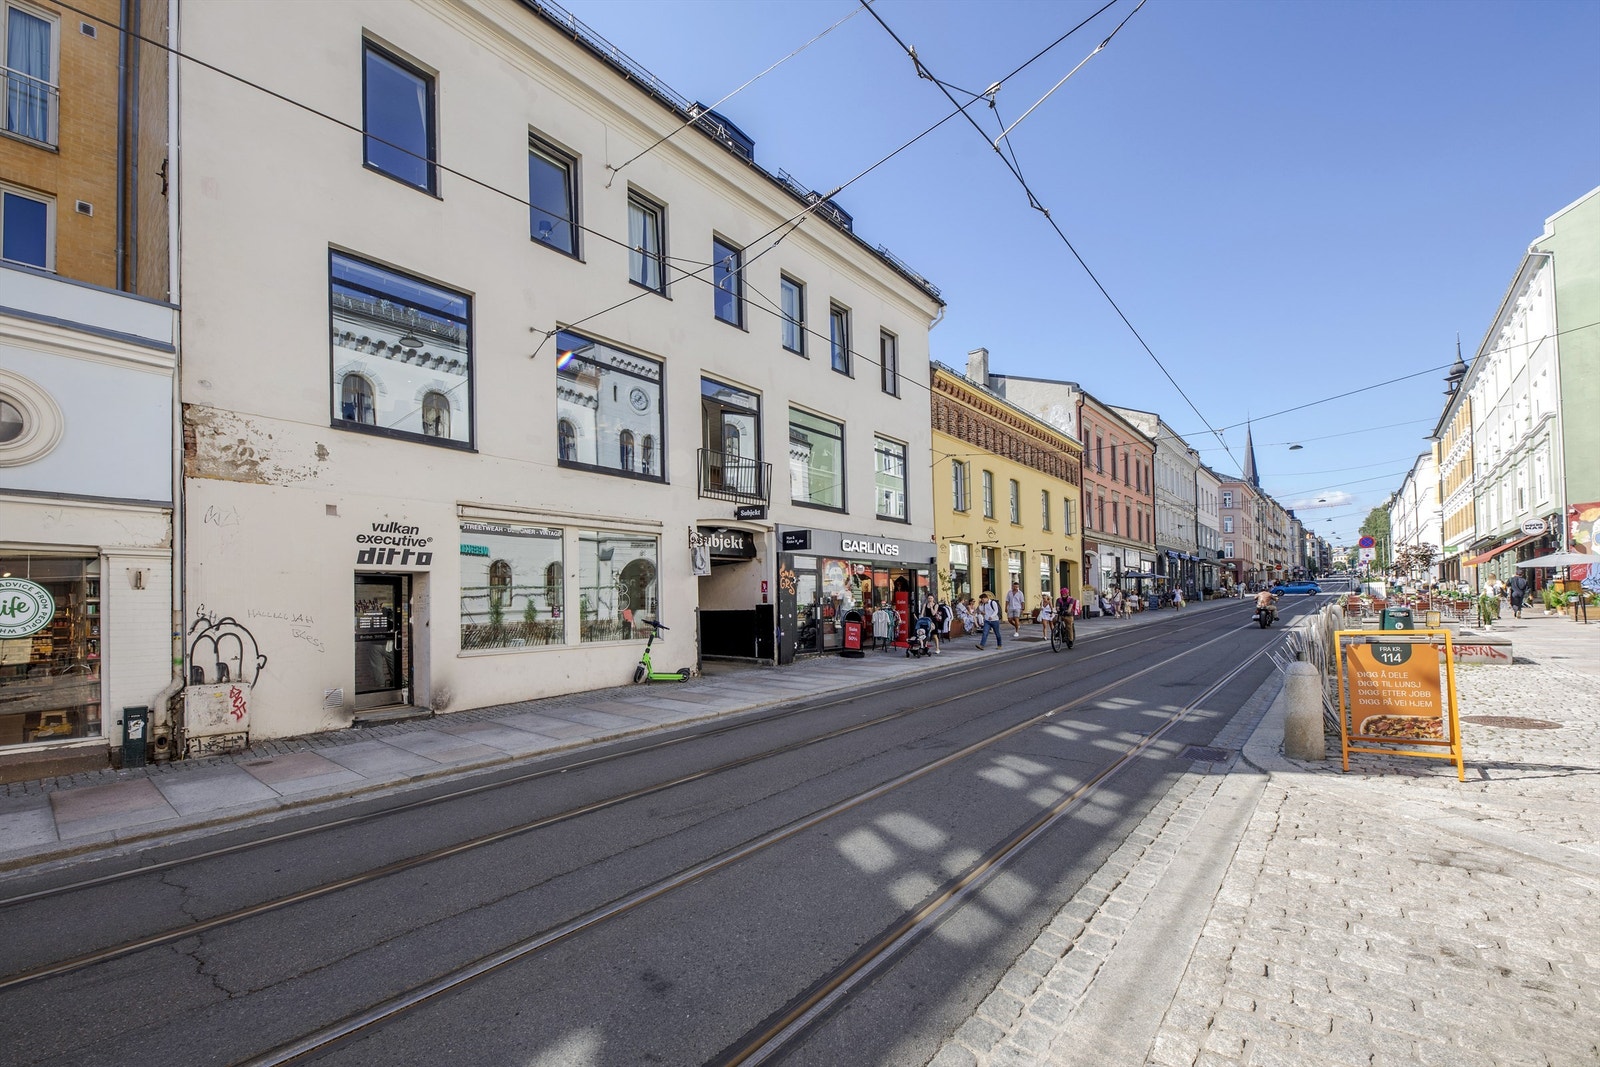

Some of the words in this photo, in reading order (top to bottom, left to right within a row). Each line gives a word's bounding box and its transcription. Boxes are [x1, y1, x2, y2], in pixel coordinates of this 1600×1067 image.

[741, 508, 761, 518] Subjekt
[371, 521, 420, 535] vulkan
[842, 539, 899, 556] CARLINGS
[356, 547, 433, 566] ditto
[0, 581, 35, 592] ADVICE
[34, 591, 48, 609] FROM
[0, 595, 30, 619] ife
[21, 611, 48, 632] PEOPLE
[1381, 653, 1402, 663] 114
[1380, 670, 1387, 678] Å
[1381, 680, 1392, 688] TIL
[1409, 690, 1431, 698] JOBB
[1383, 698, 1393, 706] PÅ
[1409, 700, 1433, 708] HJEM
